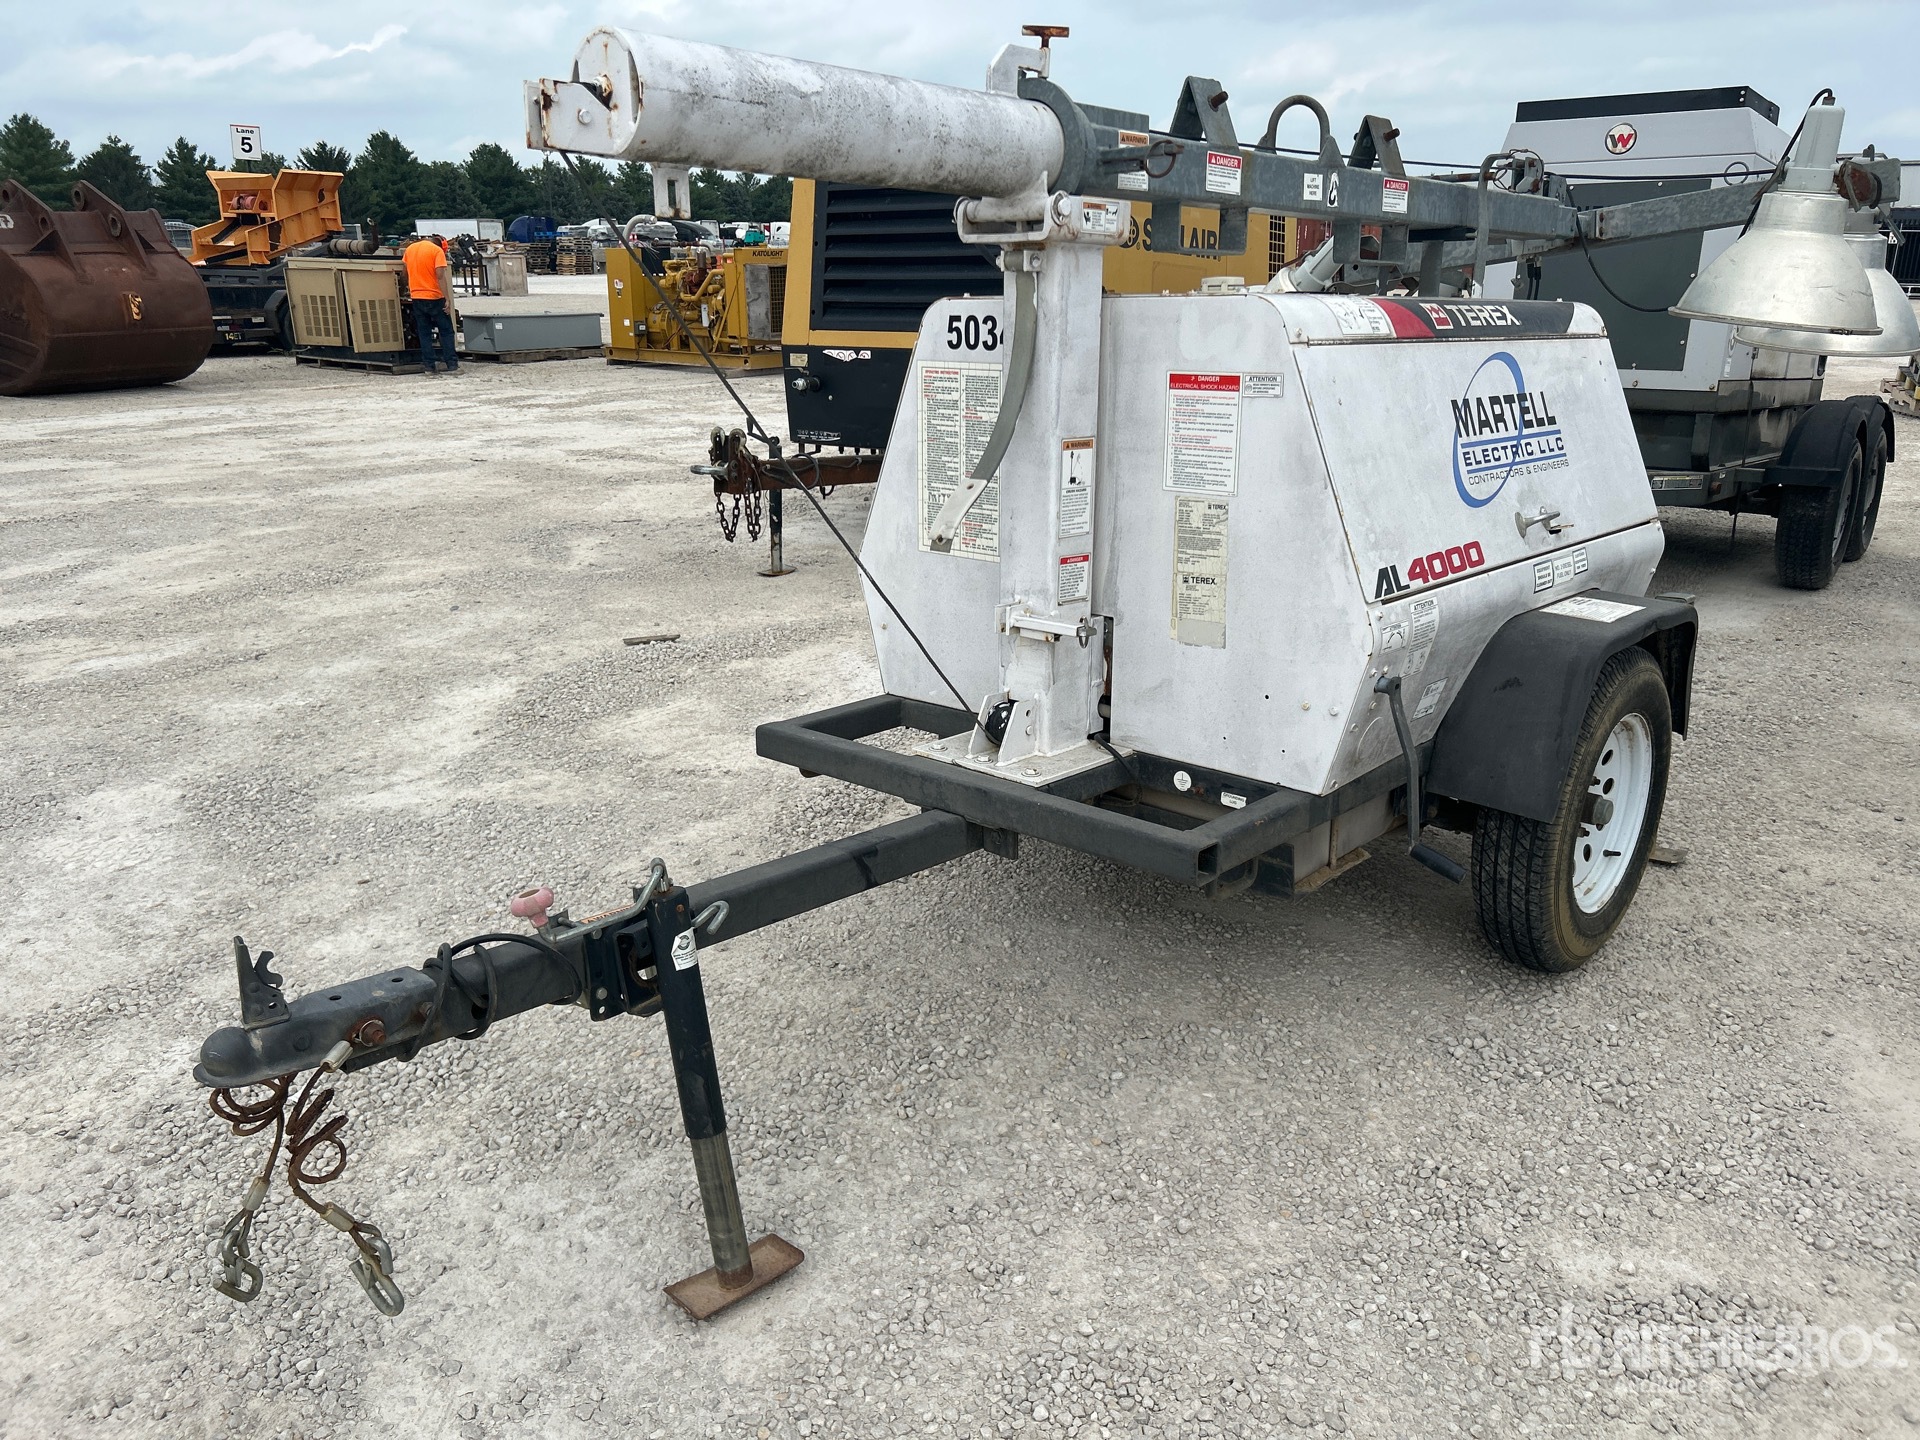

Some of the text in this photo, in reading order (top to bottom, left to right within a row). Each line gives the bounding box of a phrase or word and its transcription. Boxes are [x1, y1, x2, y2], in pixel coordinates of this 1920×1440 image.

[236, 127, 254, 135] Lane
[241, 136, 253, 153] 5
[1126, 135, 1147, 145] WARNING
[1216, 156, 1239, 168] DANGER
[1390, 181, 1406, 191] DANGER
[1143, 217, 1218, 260] SLAIR
[1445, 305, 1521, 327] TEREX
[1451, 391, 1557, 438] MARTELL
[1538, 437, 1565, 454] LLC
[1468, 458, 1570, 486] CONTRACTORS & ENGINEERS
[1190, 576, 1217, 585] TEREX
[1413, 599, 1434, 610] ATTENTION
